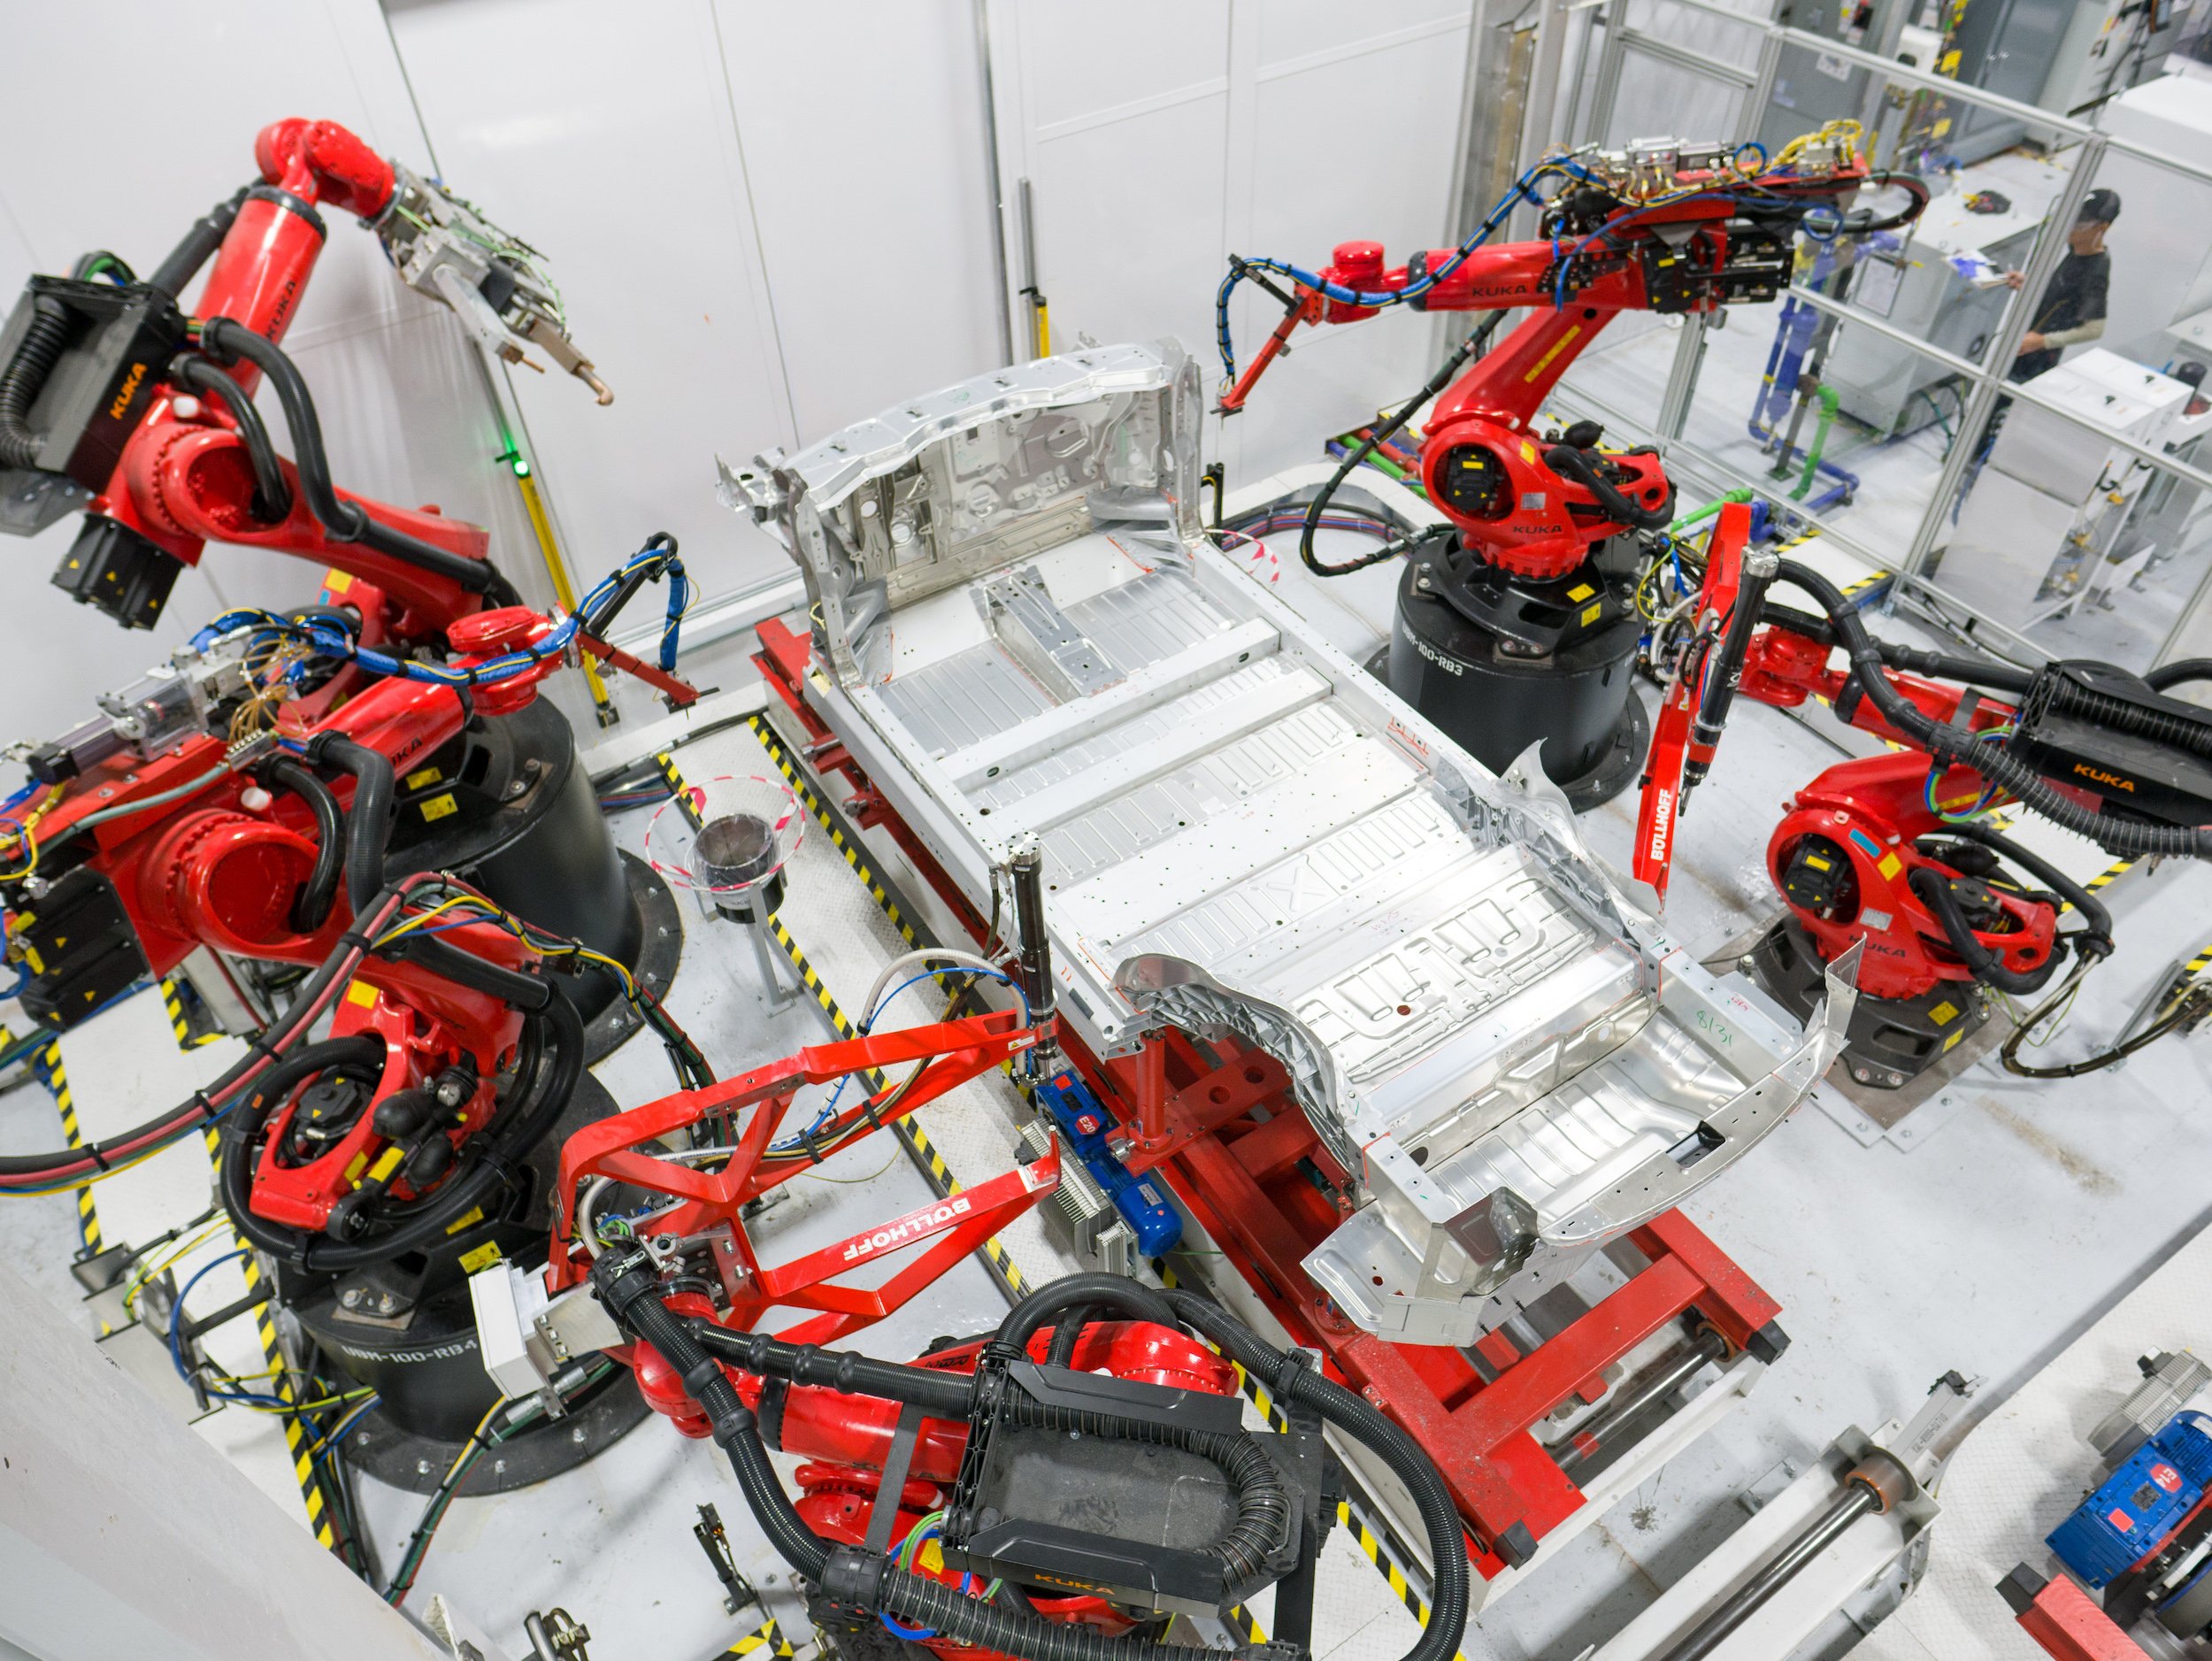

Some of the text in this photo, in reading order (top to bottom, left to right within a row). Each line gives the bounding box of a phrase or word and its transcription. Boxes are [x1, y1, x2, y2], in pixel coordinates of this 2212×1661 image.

[1471, 284, 1527, 297] KUKA
[265, 280, 296, 342] KUKA
[109, 362, 148, 420] KUKA
[1513, 524, 1563, 534] KUKA
[2073, 763, 2135, 793] KUKA
[1650, 788, 1672, 861] BÖLLHOFF
[1848, 934, 1906, 957] KUKA
[1078, 1115, 1096, 1134] E20
[842, 1197, 972, 1262] BÖLLHOFF
[1034, 1573, 1116, 1596] KUKA
